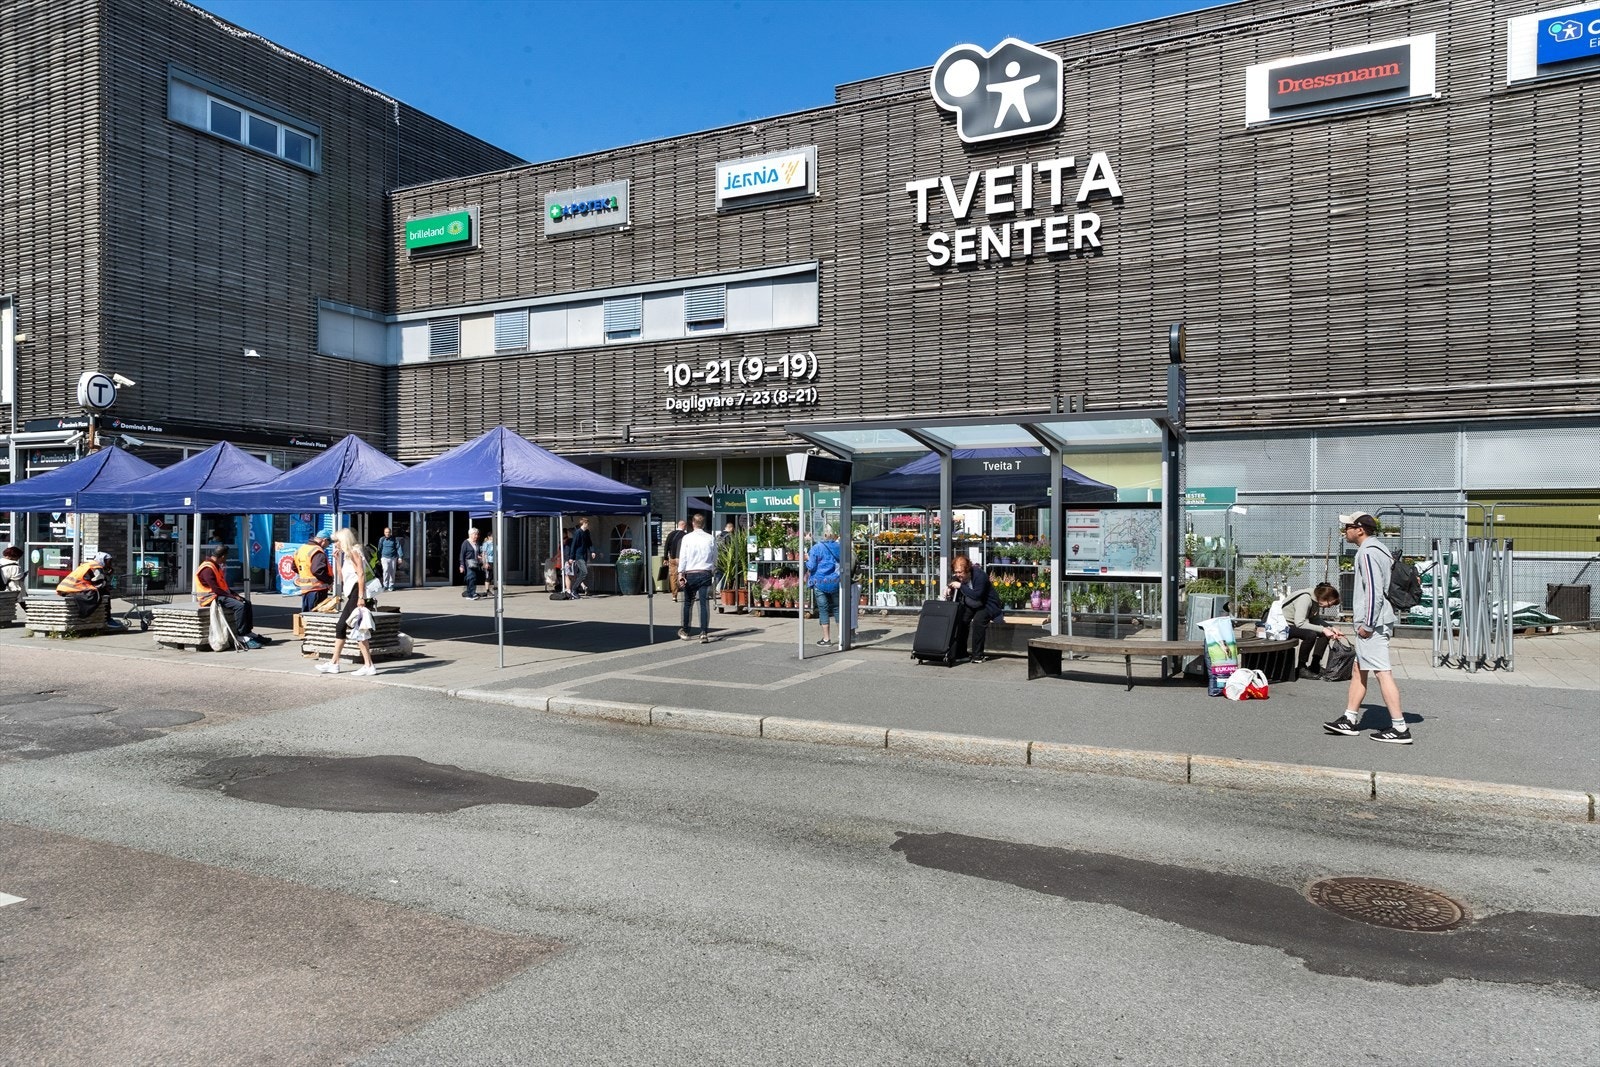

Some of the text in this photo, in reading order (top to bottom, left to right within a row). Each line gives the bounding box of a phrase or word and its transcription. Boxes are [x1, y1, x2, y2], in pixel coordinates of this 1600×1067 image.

[1278, 62, 1400, 94] Dressmann
[906, 151, 1122, 224] TVEITA
[409, 226, 445, 240] brilleland
[926, 212, 1101, 266] SENTER
[663, 351, 818, 387] 10-21 (9-19)
[666, 387, 817, 412] Dagligvare 7-23 (8-21)
[121, 422, 147, 431] Domino's
[40, 454, 67, 464] Domino's
[983, 460, 1021, 471] Tveita T
[763, 496, 792, 506] Tilbud
